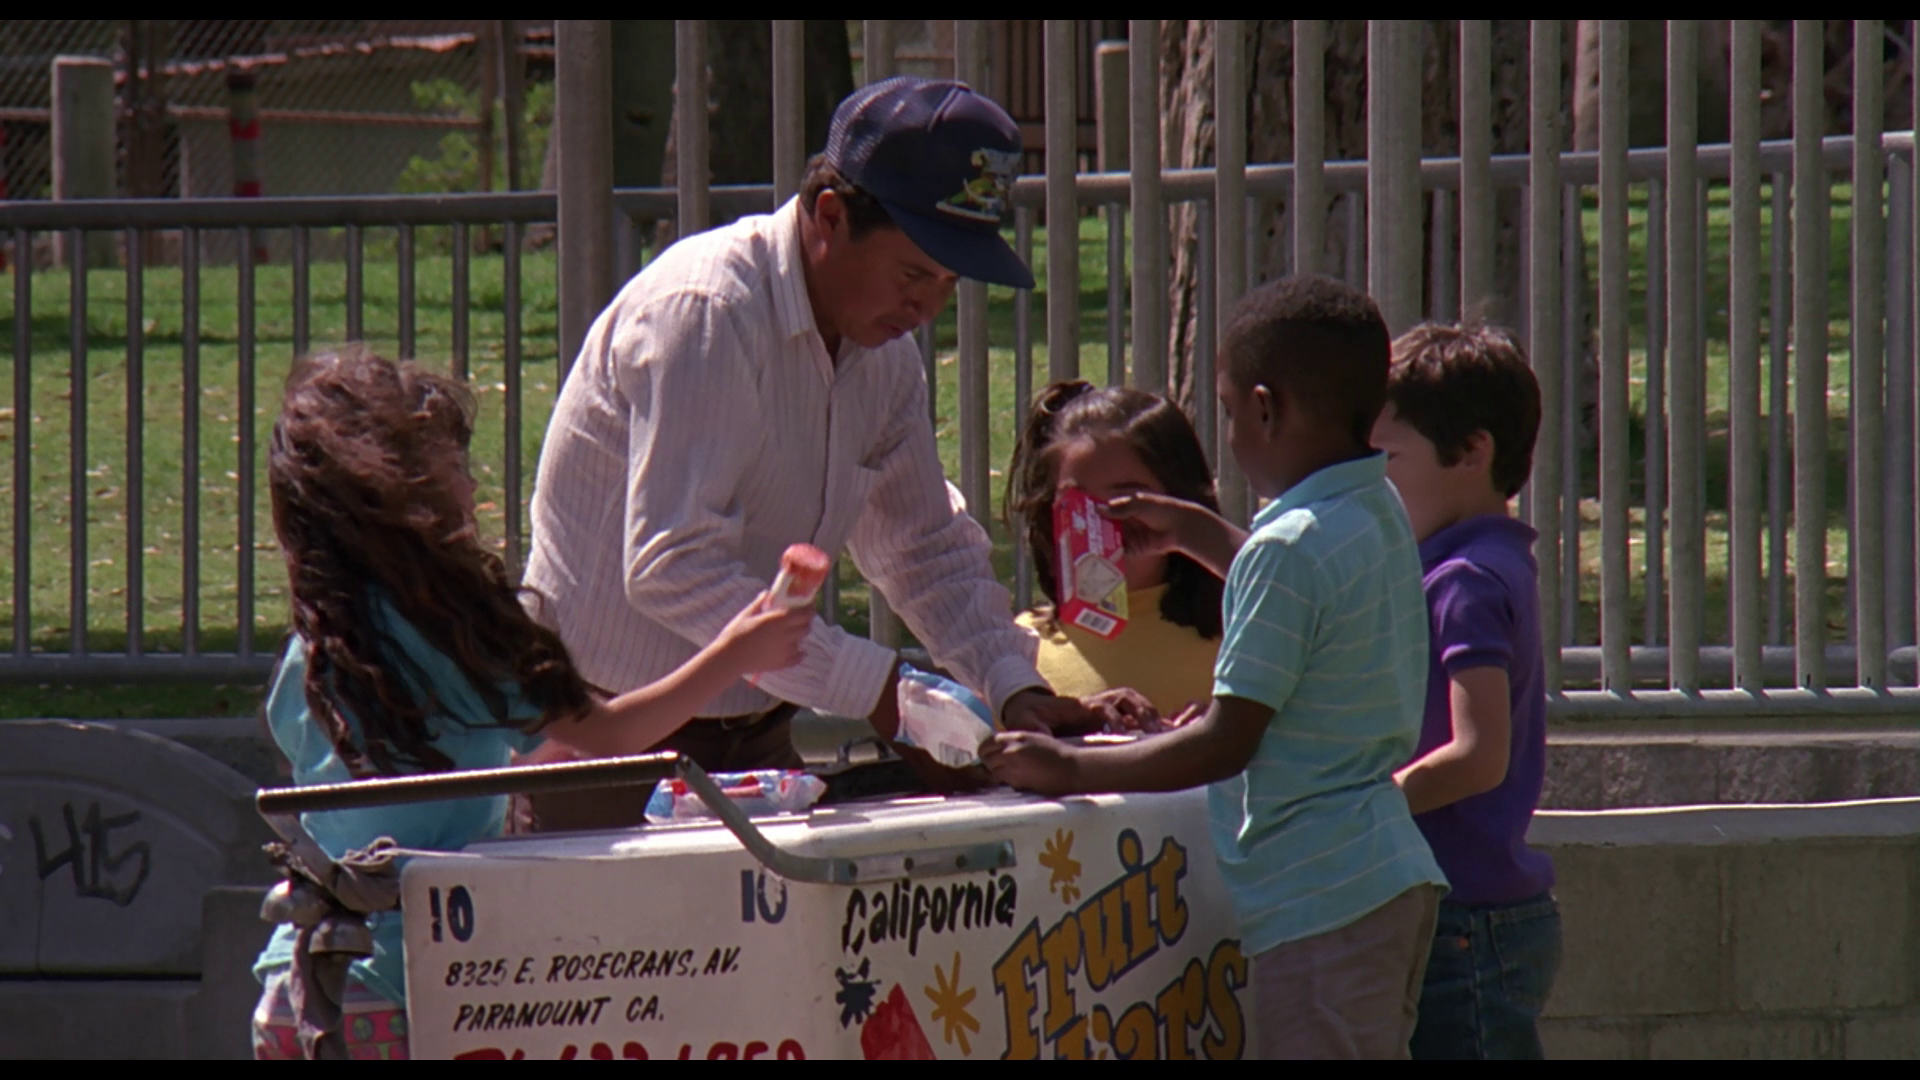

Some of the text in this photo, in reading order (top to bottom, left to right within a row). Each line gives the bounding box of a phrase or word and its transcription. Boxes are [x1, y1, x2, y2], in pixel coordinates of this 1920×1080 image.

[428, 884, 475, 943] 10
[740, 869, 788, 925] 10
[841, 867, 1018, 956] California
[445, 946, 741, 987] 8325 E. ROSECRANS, AV.
[992, 828, 1189, 1060] Fruit
[452, 995, 665, 1033] PARAMOUNT CA.
